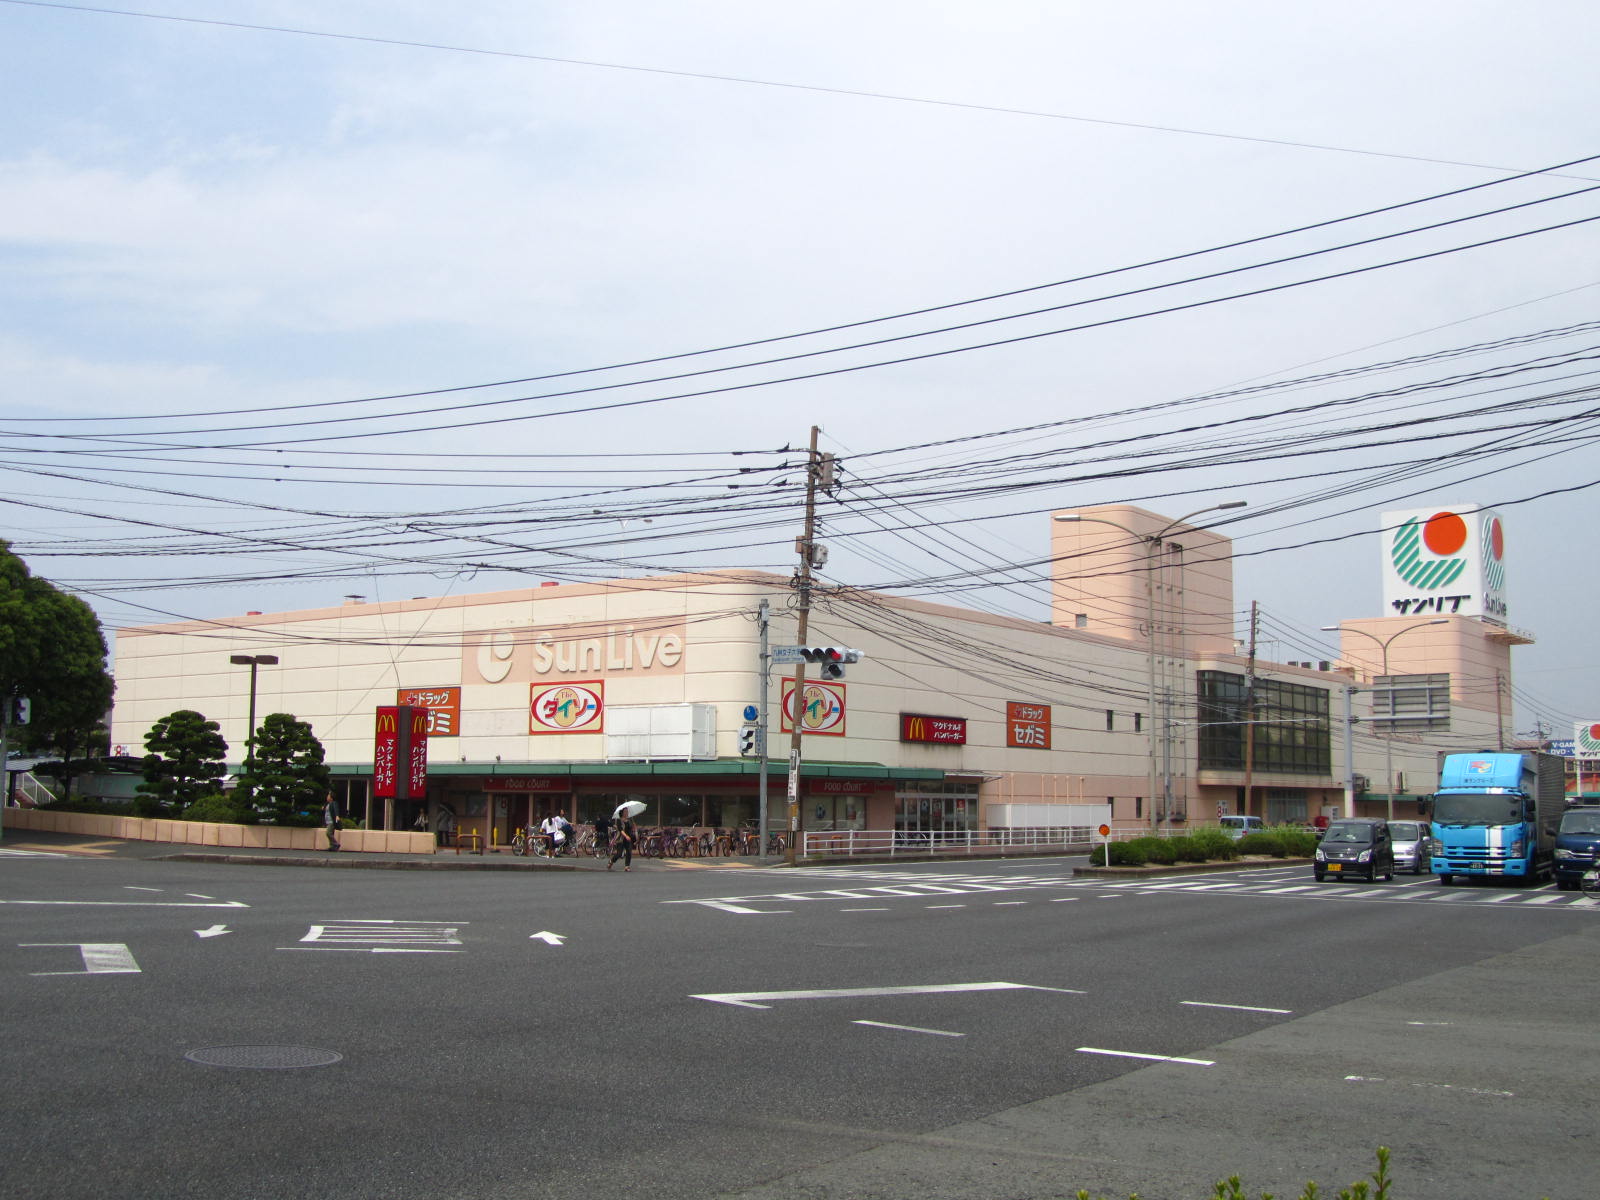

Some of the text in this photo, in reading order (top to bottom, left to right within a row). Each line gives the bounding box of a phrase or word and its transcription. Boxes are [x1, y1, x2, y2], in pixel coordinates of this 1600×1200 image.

[533, 625, 683, 674] SunLive
[418, 691, 450, 705] ドラッグ
[543, 698, 596, 718] ダイソー
[1022, 707, 1044, 720] ドラッグ
[932, 721, 962, 731] マクドナルド
[934, 731, 964, 740] ハンバーガー
[1014, 724, 1045, 746] セガミ
[376, 746, 385, 790] ハンバーガー
[385, 739, 395, 786] マクドナルド
[419, 740, 427, 787] マクドナルド
[824, 782, 861, 791] FOOD COURT
